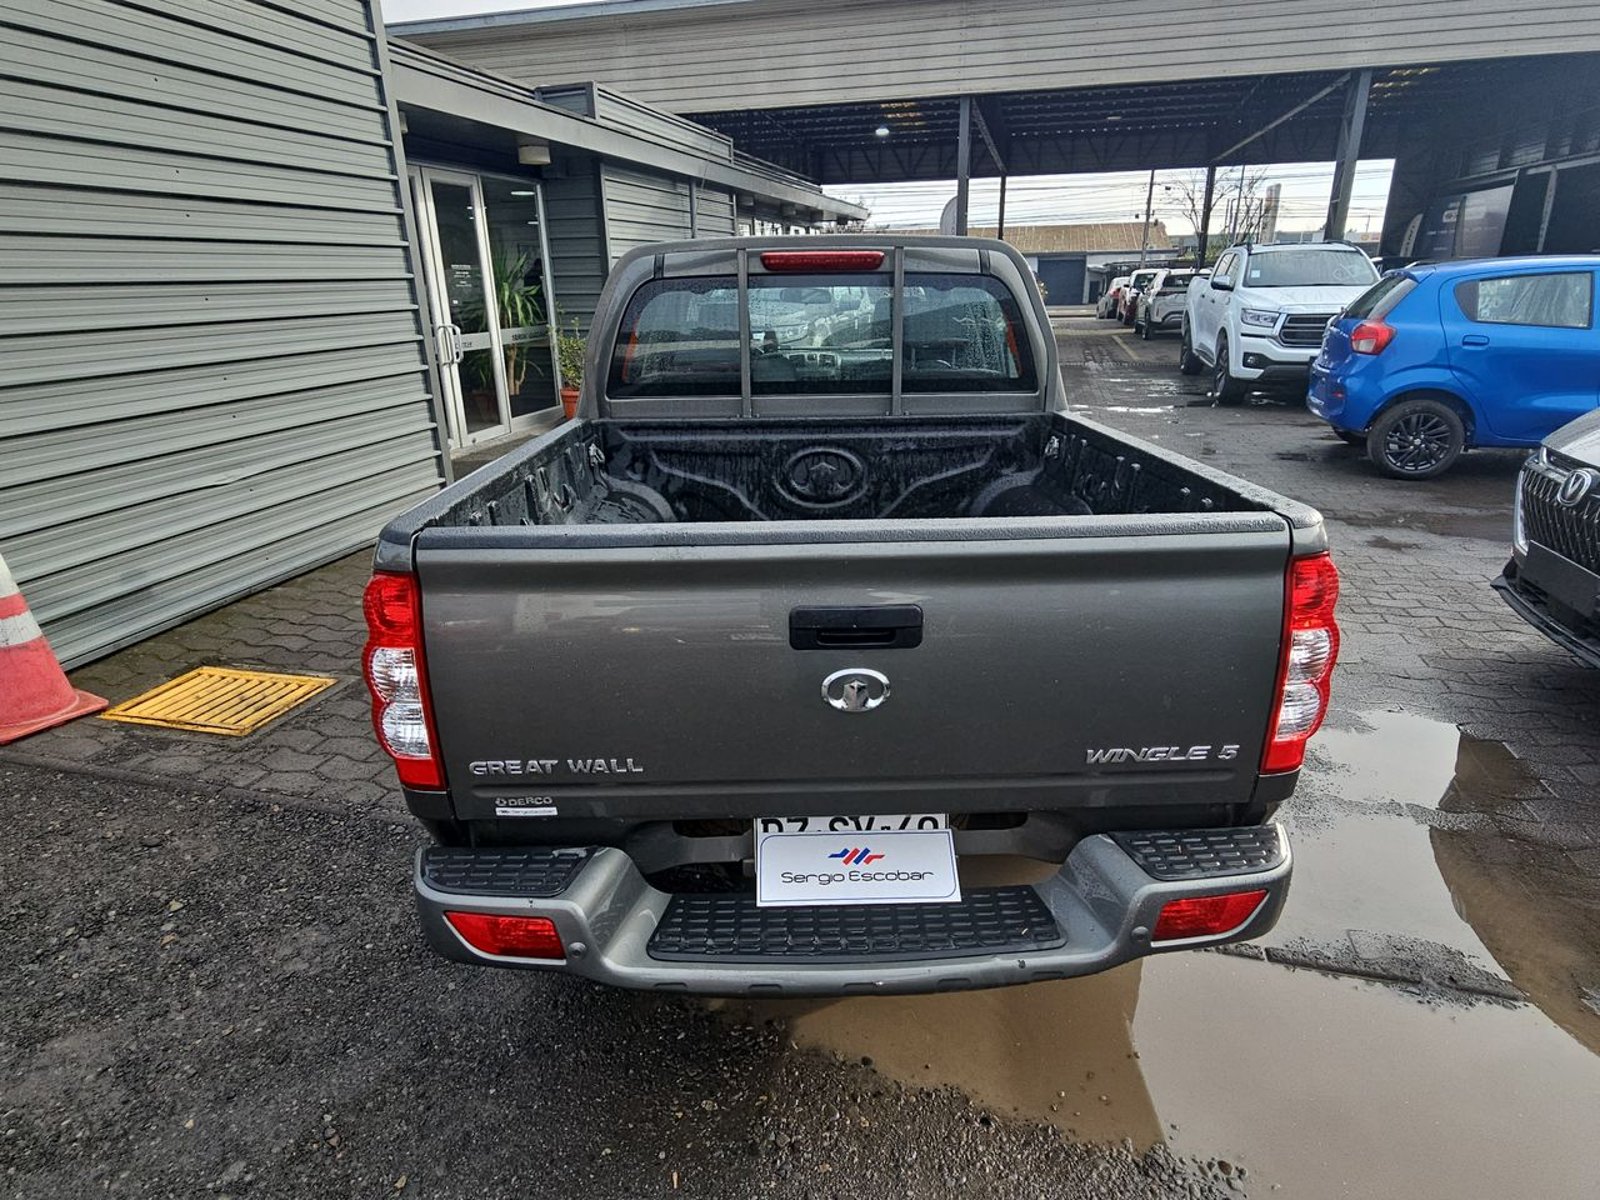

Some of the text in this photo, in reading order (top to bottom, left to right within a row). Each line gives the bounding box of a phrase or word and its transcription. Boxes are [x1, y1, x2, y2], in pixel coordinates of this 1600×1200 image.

[1086, 744, 1240, 764] WINGLE 5
[468, 758, 644, 775] GREAT WALL
[508, 796, 553, 807] DERCO
[780, 869, 935, 886] Sergio Escobar
